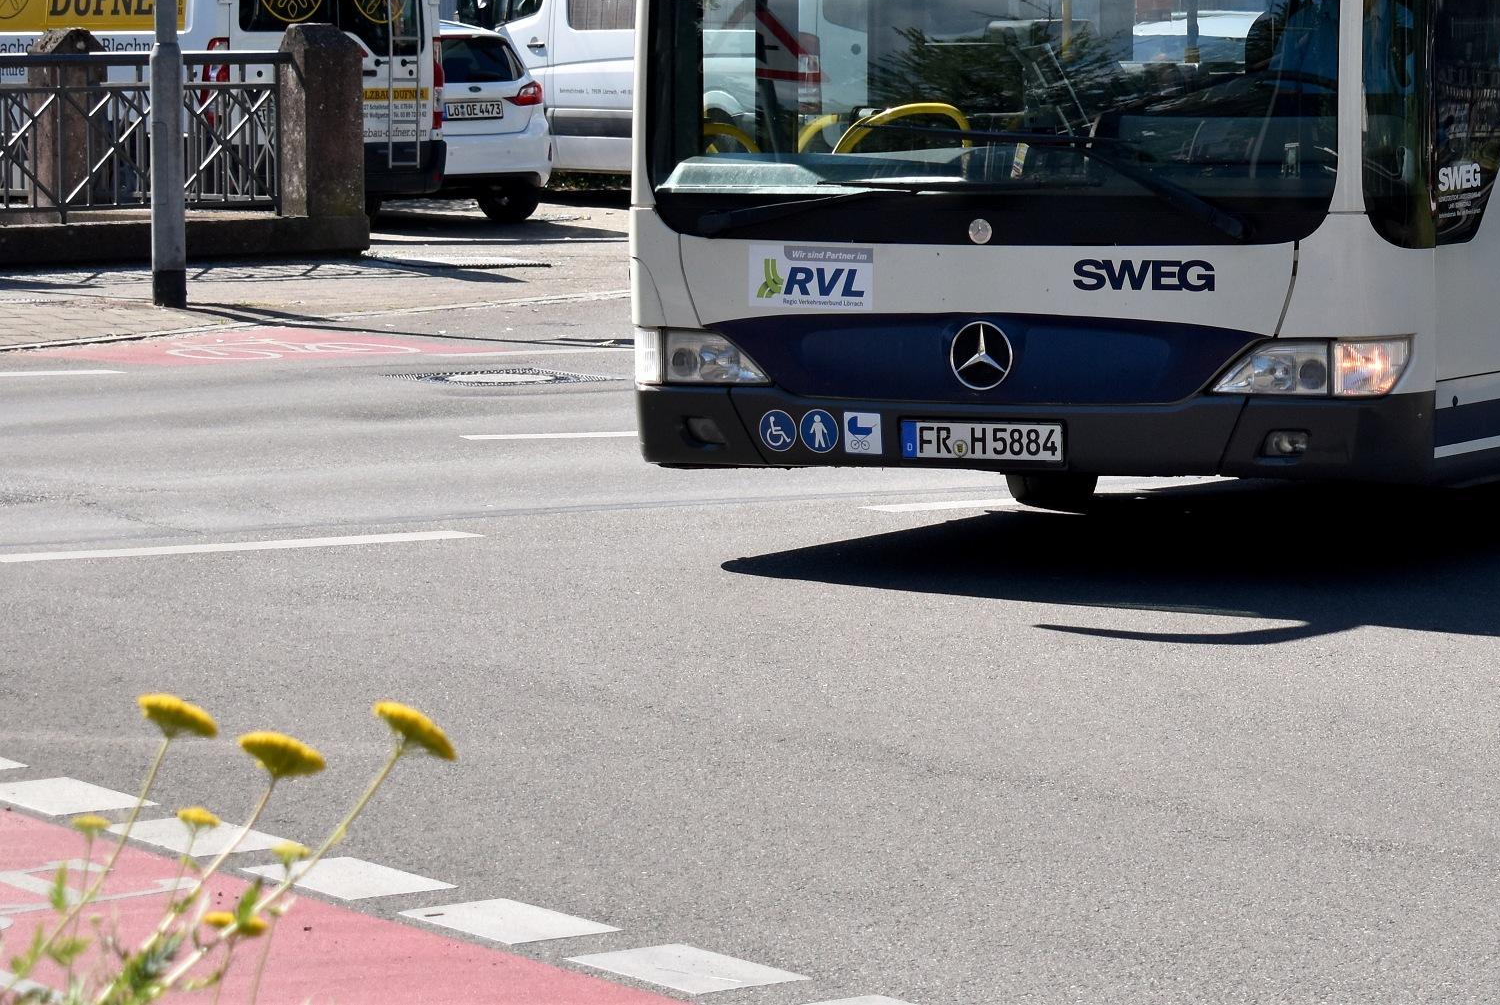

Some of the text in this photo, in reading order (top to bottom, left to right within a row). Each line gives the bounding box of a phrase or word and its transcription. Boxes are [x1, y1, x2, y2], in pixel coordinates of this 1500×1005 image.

[447, 102, 460, 117] LÖ
[479, 102, 501, 116] 4473
[1438, 162, 1481, 191] SWEG
[792, 250, 867, 261] Wir sind Partner im
[783, 266, 865, 298] RVL
[1073, 258, 1216, 292] SWEG
[919, 426, 952, 454] FR
